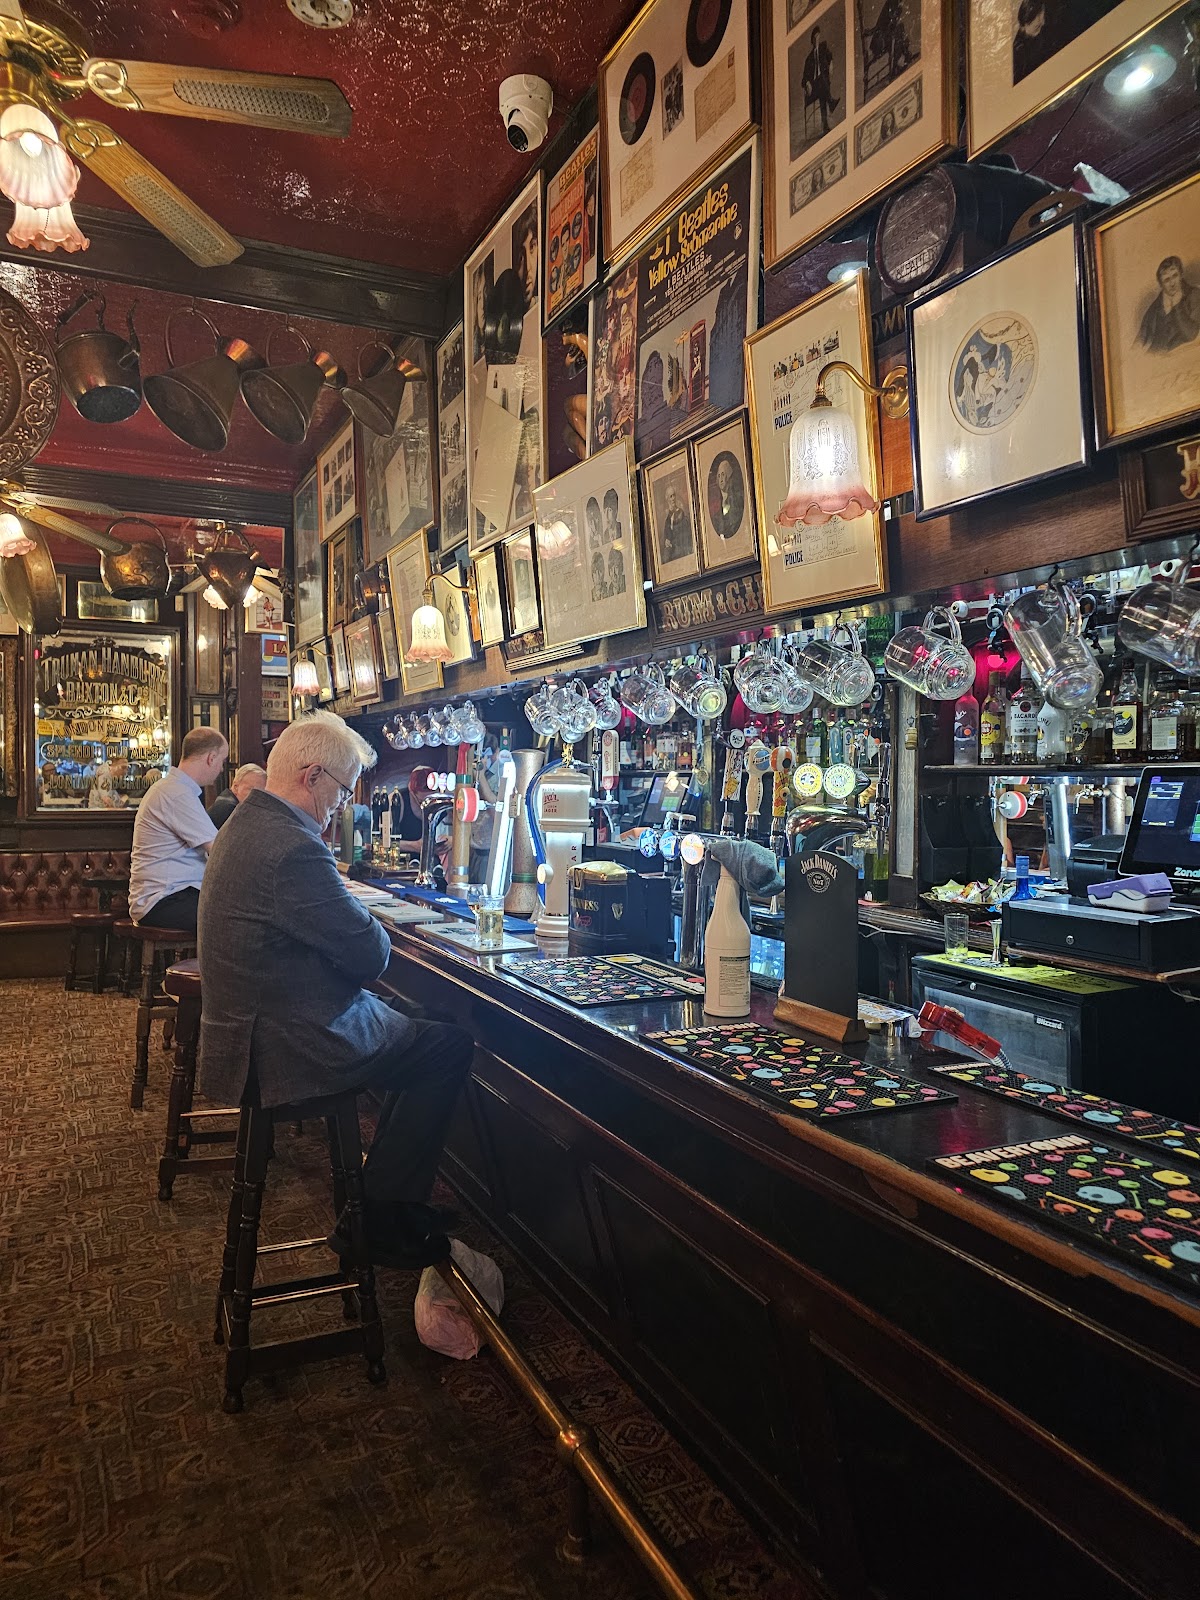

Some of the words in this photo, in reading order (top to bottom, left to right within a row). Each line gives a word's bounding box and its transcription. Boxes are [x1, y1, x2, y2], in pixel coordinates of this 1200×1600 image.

[678, 182, 729, 244] Beatles
[648, 251, 680, 290] Yellow
[671, 250, 705, 286] BEATLES
[774, 410, 794, 431] POLICE
[784, 550, 804, 566] POLICE
[660, 588, 717, 633] RUM
[716, 591, 729, 615] &
[41, 650, 99, 693] TRUMAN
[101, 646, 167, 699] HANBURY
[66, 681, 118, 703] BUXTON
[56, 718, 105, 739] LONDON
[107, 719, 146, 738] STOUT
[46, 744, 102, 759] SPLENDID
[106, 745, 128, 759] OLD
[130, 745, 160, 760] ALES
[48, 774, 99, 790] LONDON
[800, 858, 815, 875] JACK
[814, 853, 839, 881] DANIEL'S
[934, 1134, 1092, 1169] BEAVERTOWN
